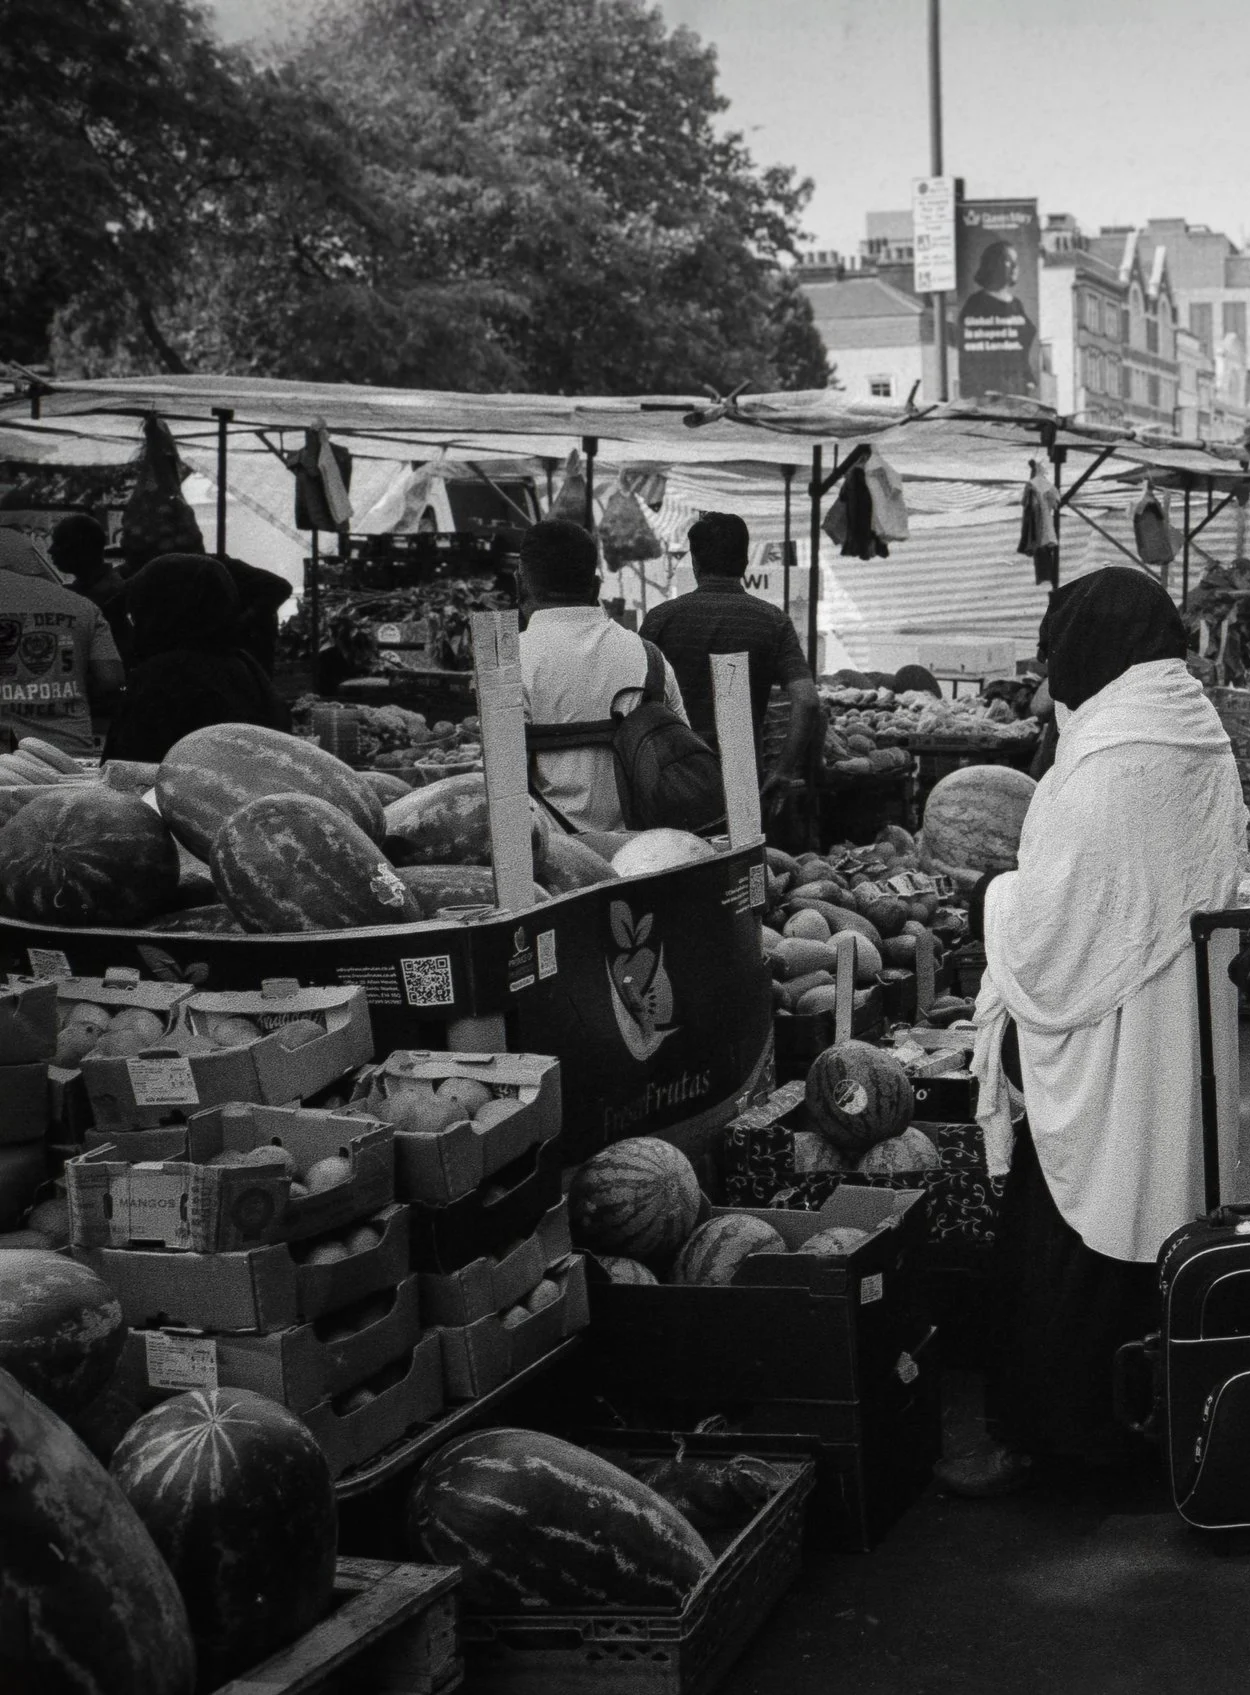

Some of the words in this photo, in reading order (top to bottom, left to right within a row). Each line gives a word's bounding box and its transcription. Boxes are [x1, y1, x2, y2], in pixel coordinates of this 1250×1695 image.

[33, 612, 77, 629] DEPT
[62, 649, 73, 672] 5
[119, 1199, 176, 1208] MANGOS
